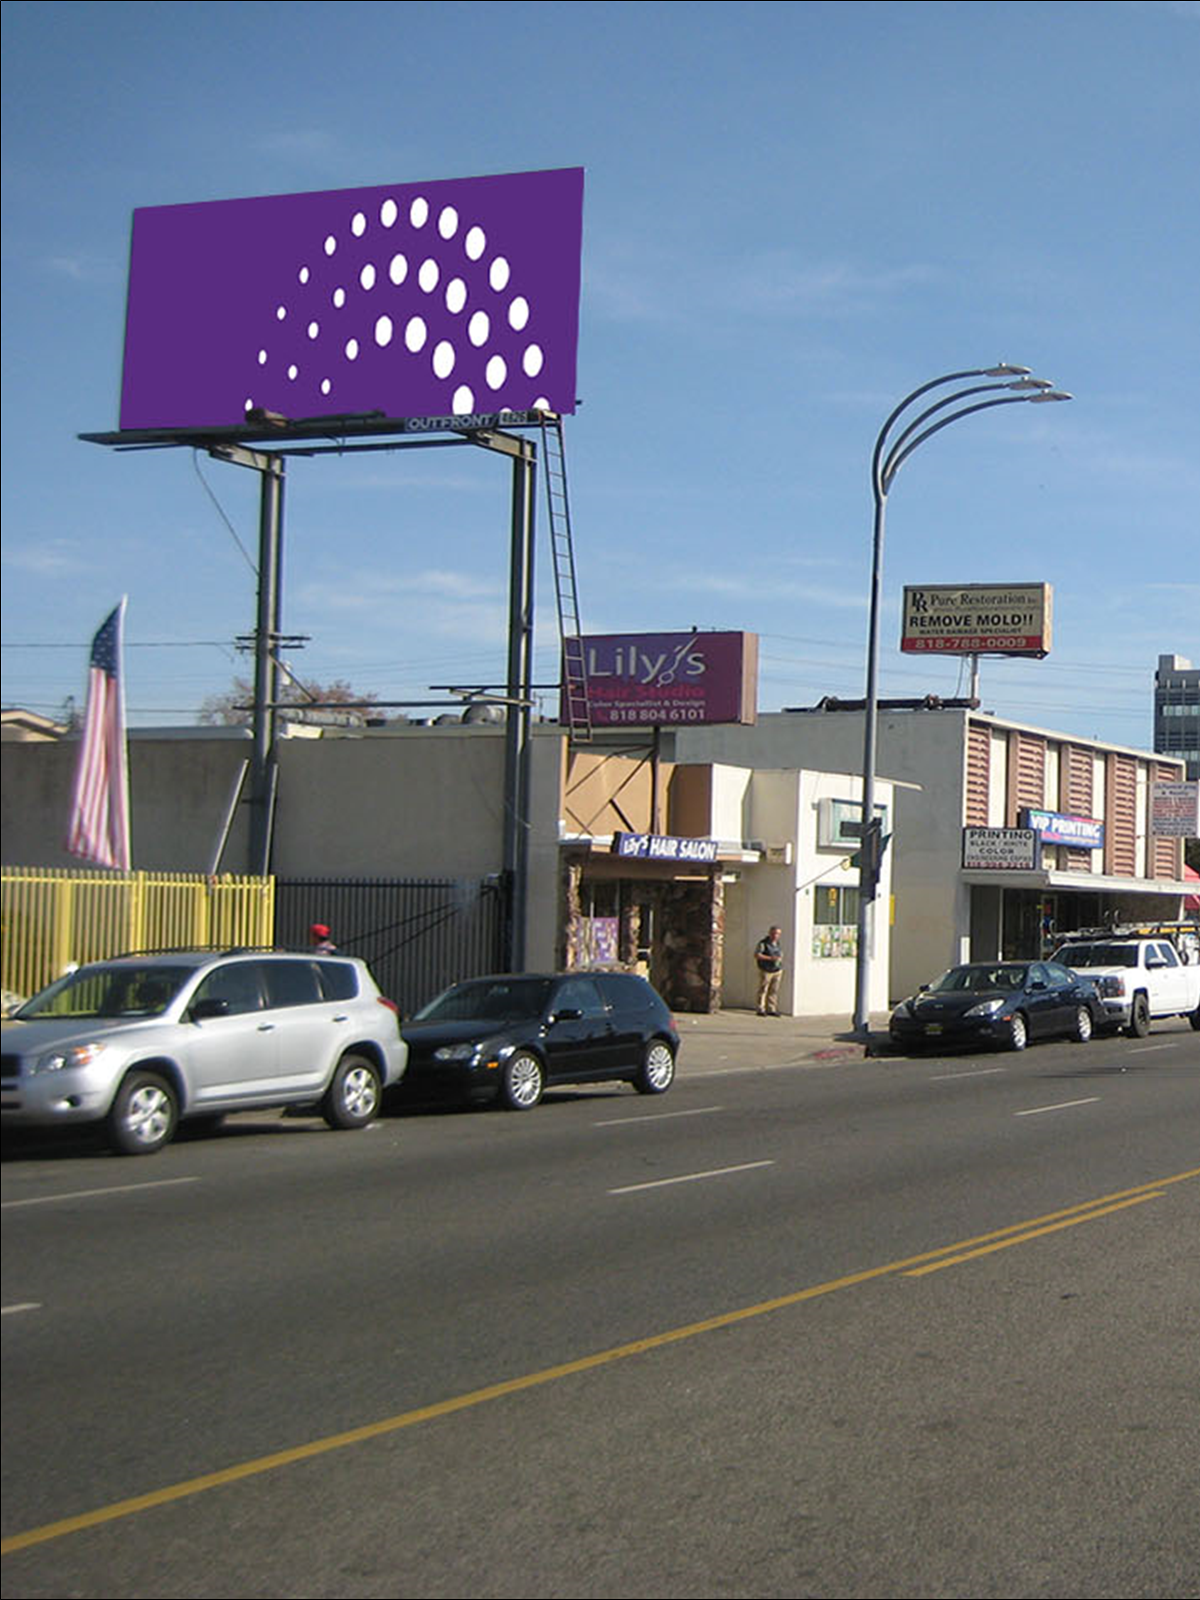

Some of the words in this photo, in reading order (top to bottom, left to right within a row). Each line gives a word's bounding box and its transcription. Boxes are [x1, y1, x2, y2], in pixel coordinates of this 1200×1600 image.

[931, 593, 957, 606] Pure
[960, 592, 1026, 606] Restoration
[909, 614, 972, 628] REMOVE
[976, 613, 1034, 627] MOLD!!
[588, 644, 706, 685] Lily's
[634, 684, 705, 698] Studio
[609, 709, 637, 721] 818
[639, 709, 667, 721] 804
[669, 708, 705, 720] 6101
[1051, 817, 1101, 838] PRINTING
[968, 829, 1033, 841] PRINTING
[650, 838, 678, 858] HAIR
[679, 840, 717, 861] SALON
[970, 840, 996, 848] BLACK
